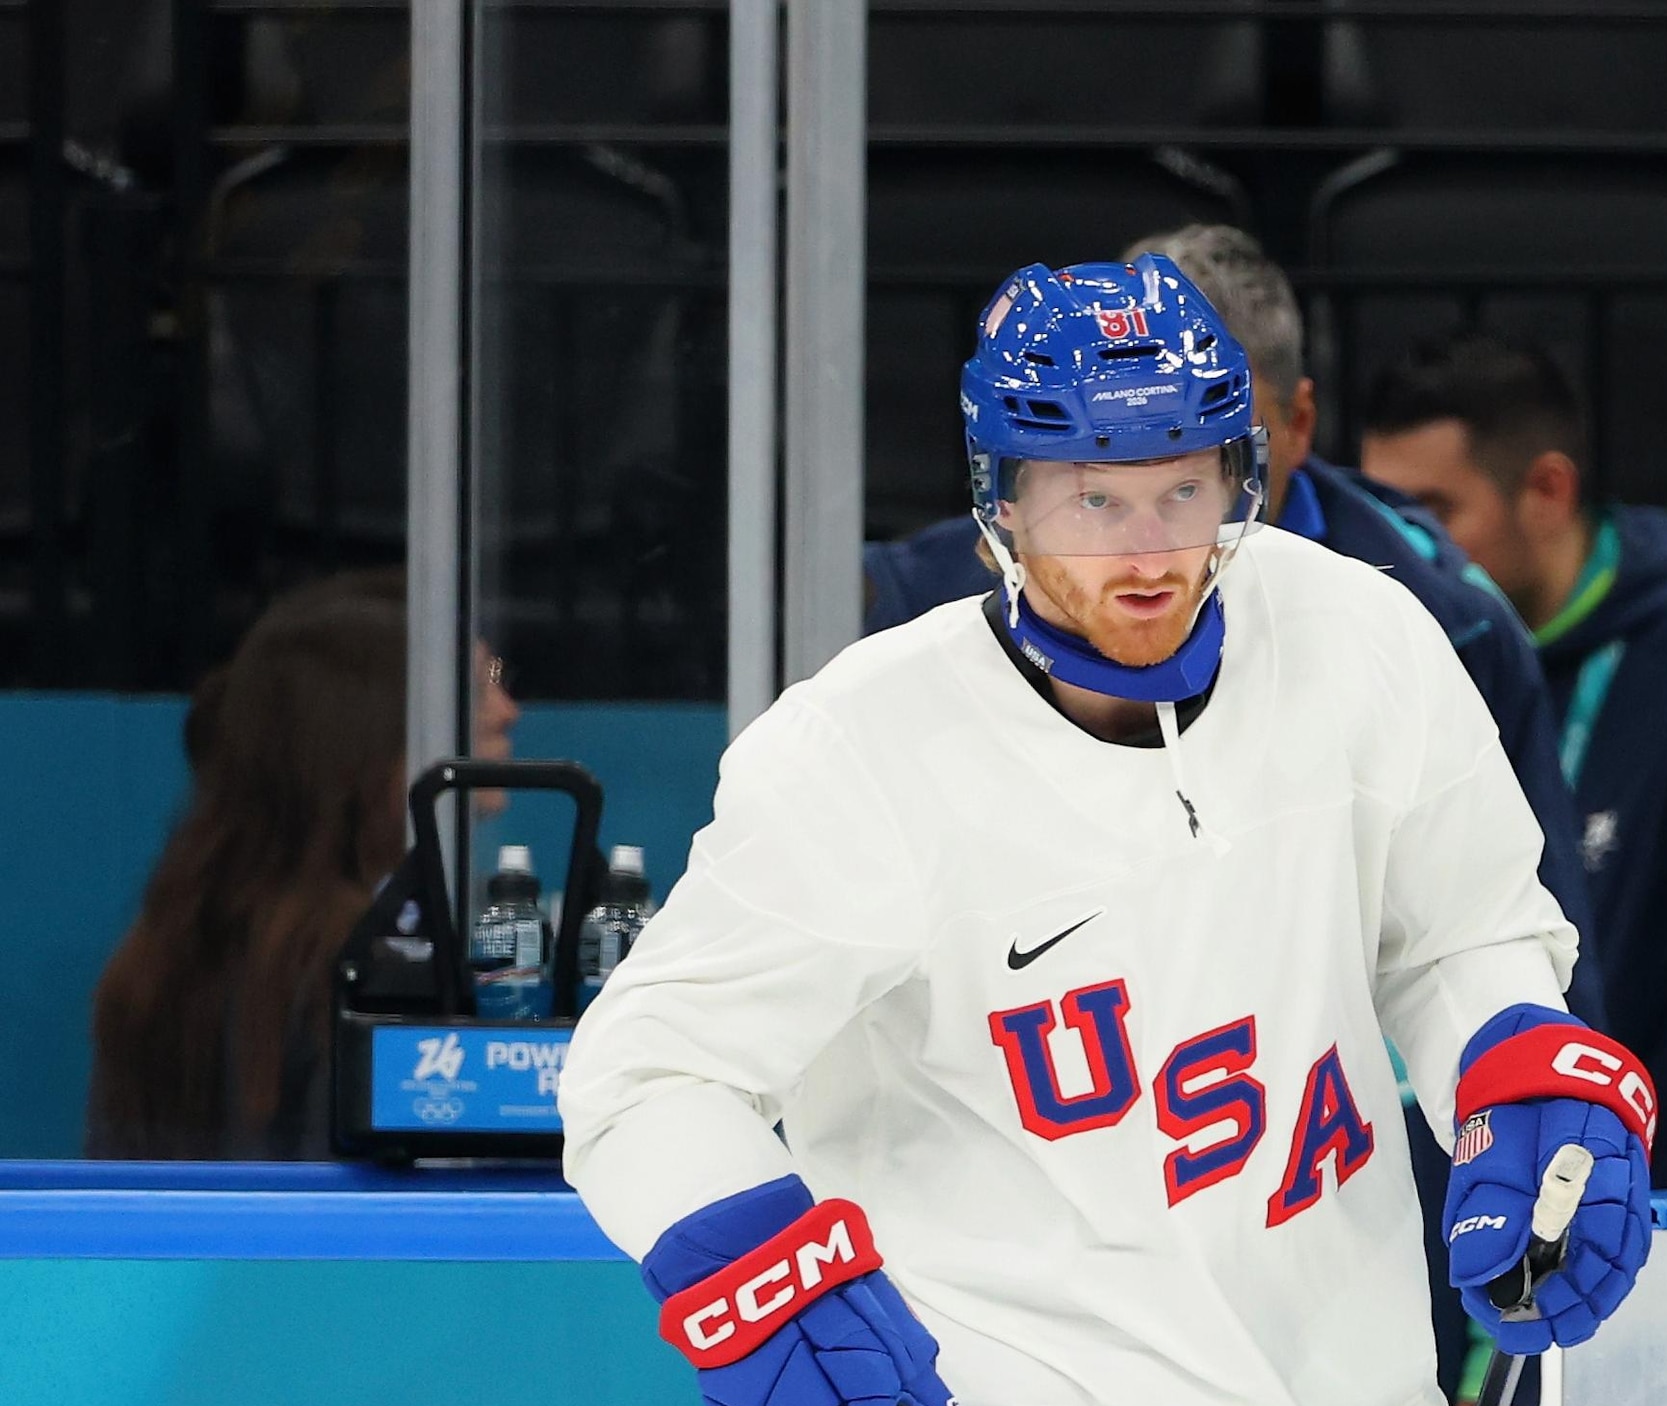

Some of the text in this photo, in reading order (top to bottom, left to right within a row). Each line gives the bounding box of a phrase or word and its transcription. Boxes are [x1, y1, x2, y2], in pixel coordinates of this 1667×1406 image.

[1092, 385, 1178, 402] MILANO CORTINA
[1025, 644, 1046, 667] USA
[988, 978, 1375, 1229] USA
[1449, 1214, 1508, 1244] CCM
[683, 1219, 856, 1351] CCM
